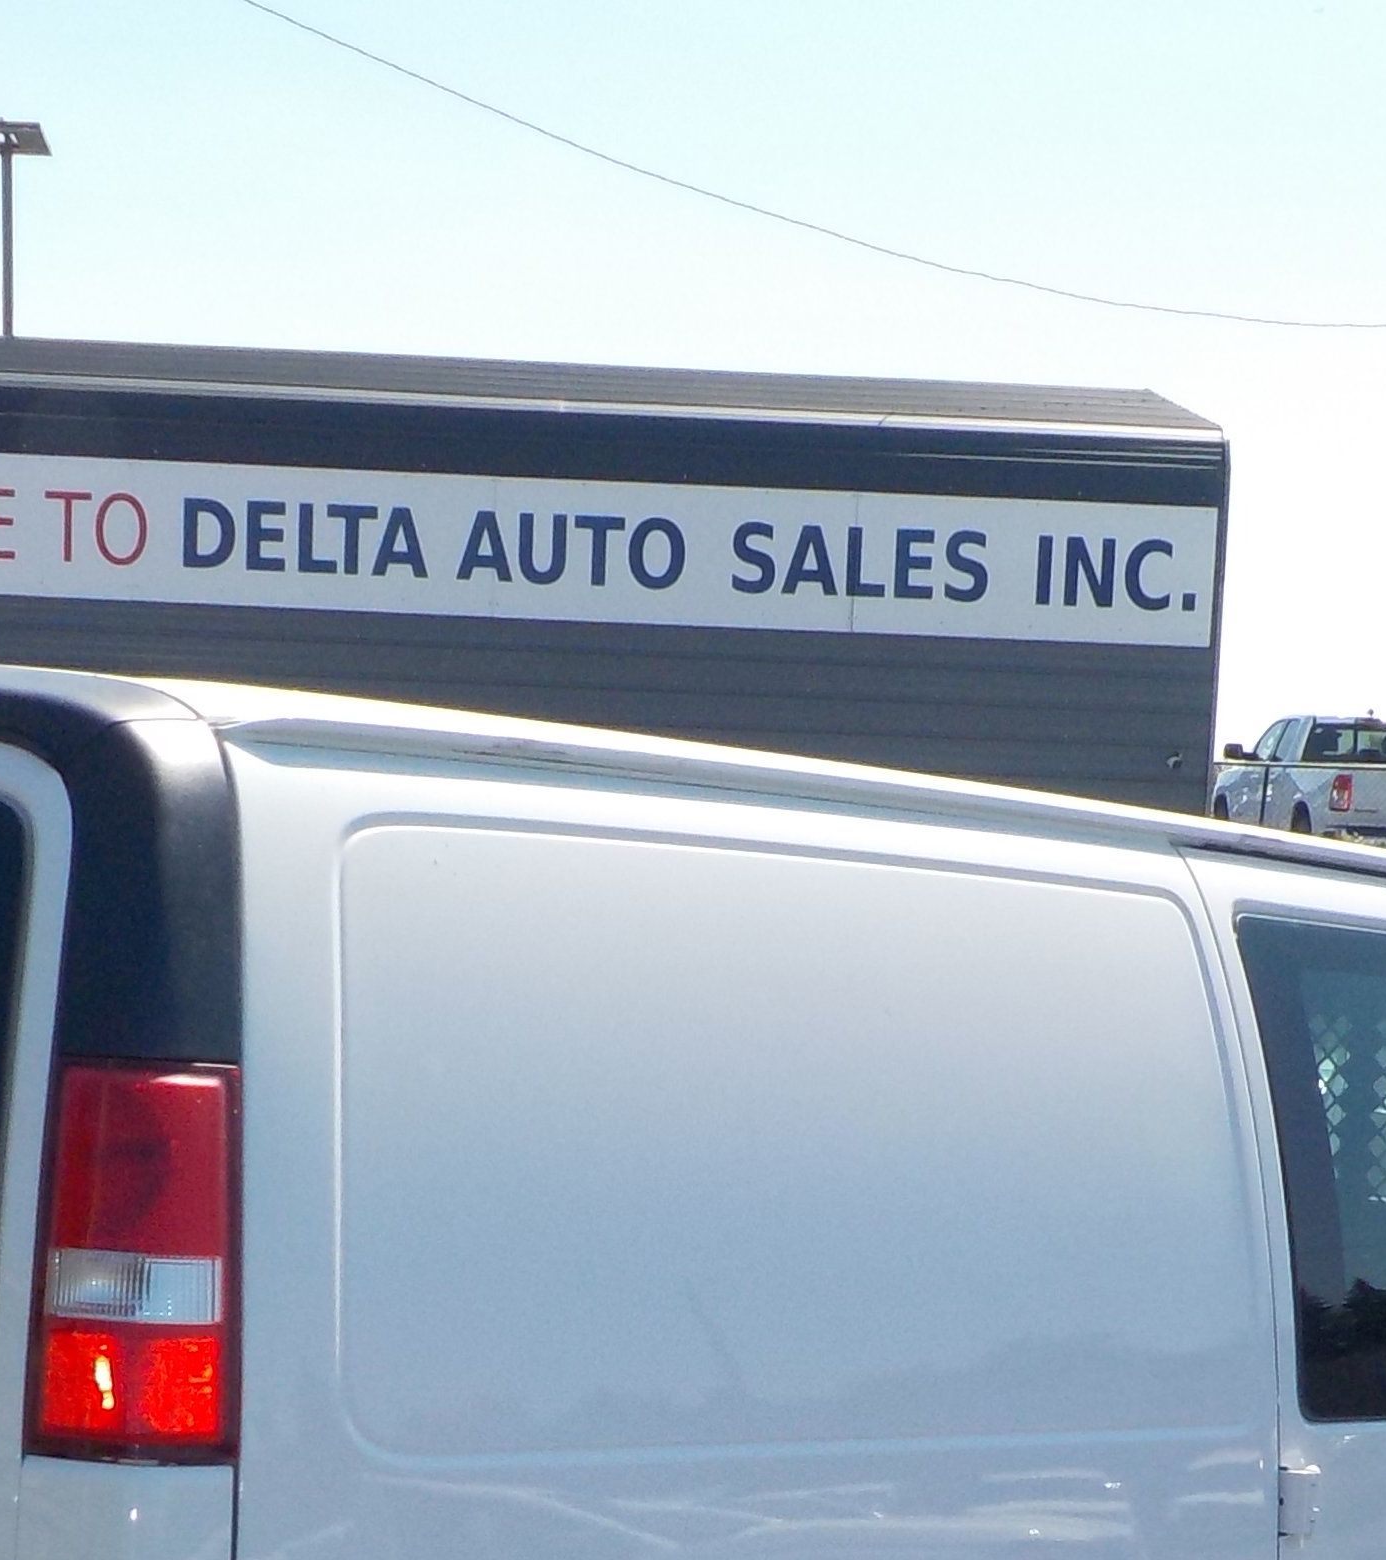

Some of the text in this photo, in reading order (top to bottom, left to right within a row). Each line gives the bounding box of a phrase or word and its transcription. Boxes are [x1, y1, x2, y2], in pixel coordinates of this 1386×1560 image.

[43, 489, 149, 567] TO
[181, 497, 430, 580] DELTA
[455, 510, 687, 591] AUTO
[730, 521, 990, 604] SALES
[1034, 533, 1198, 613] INC.
